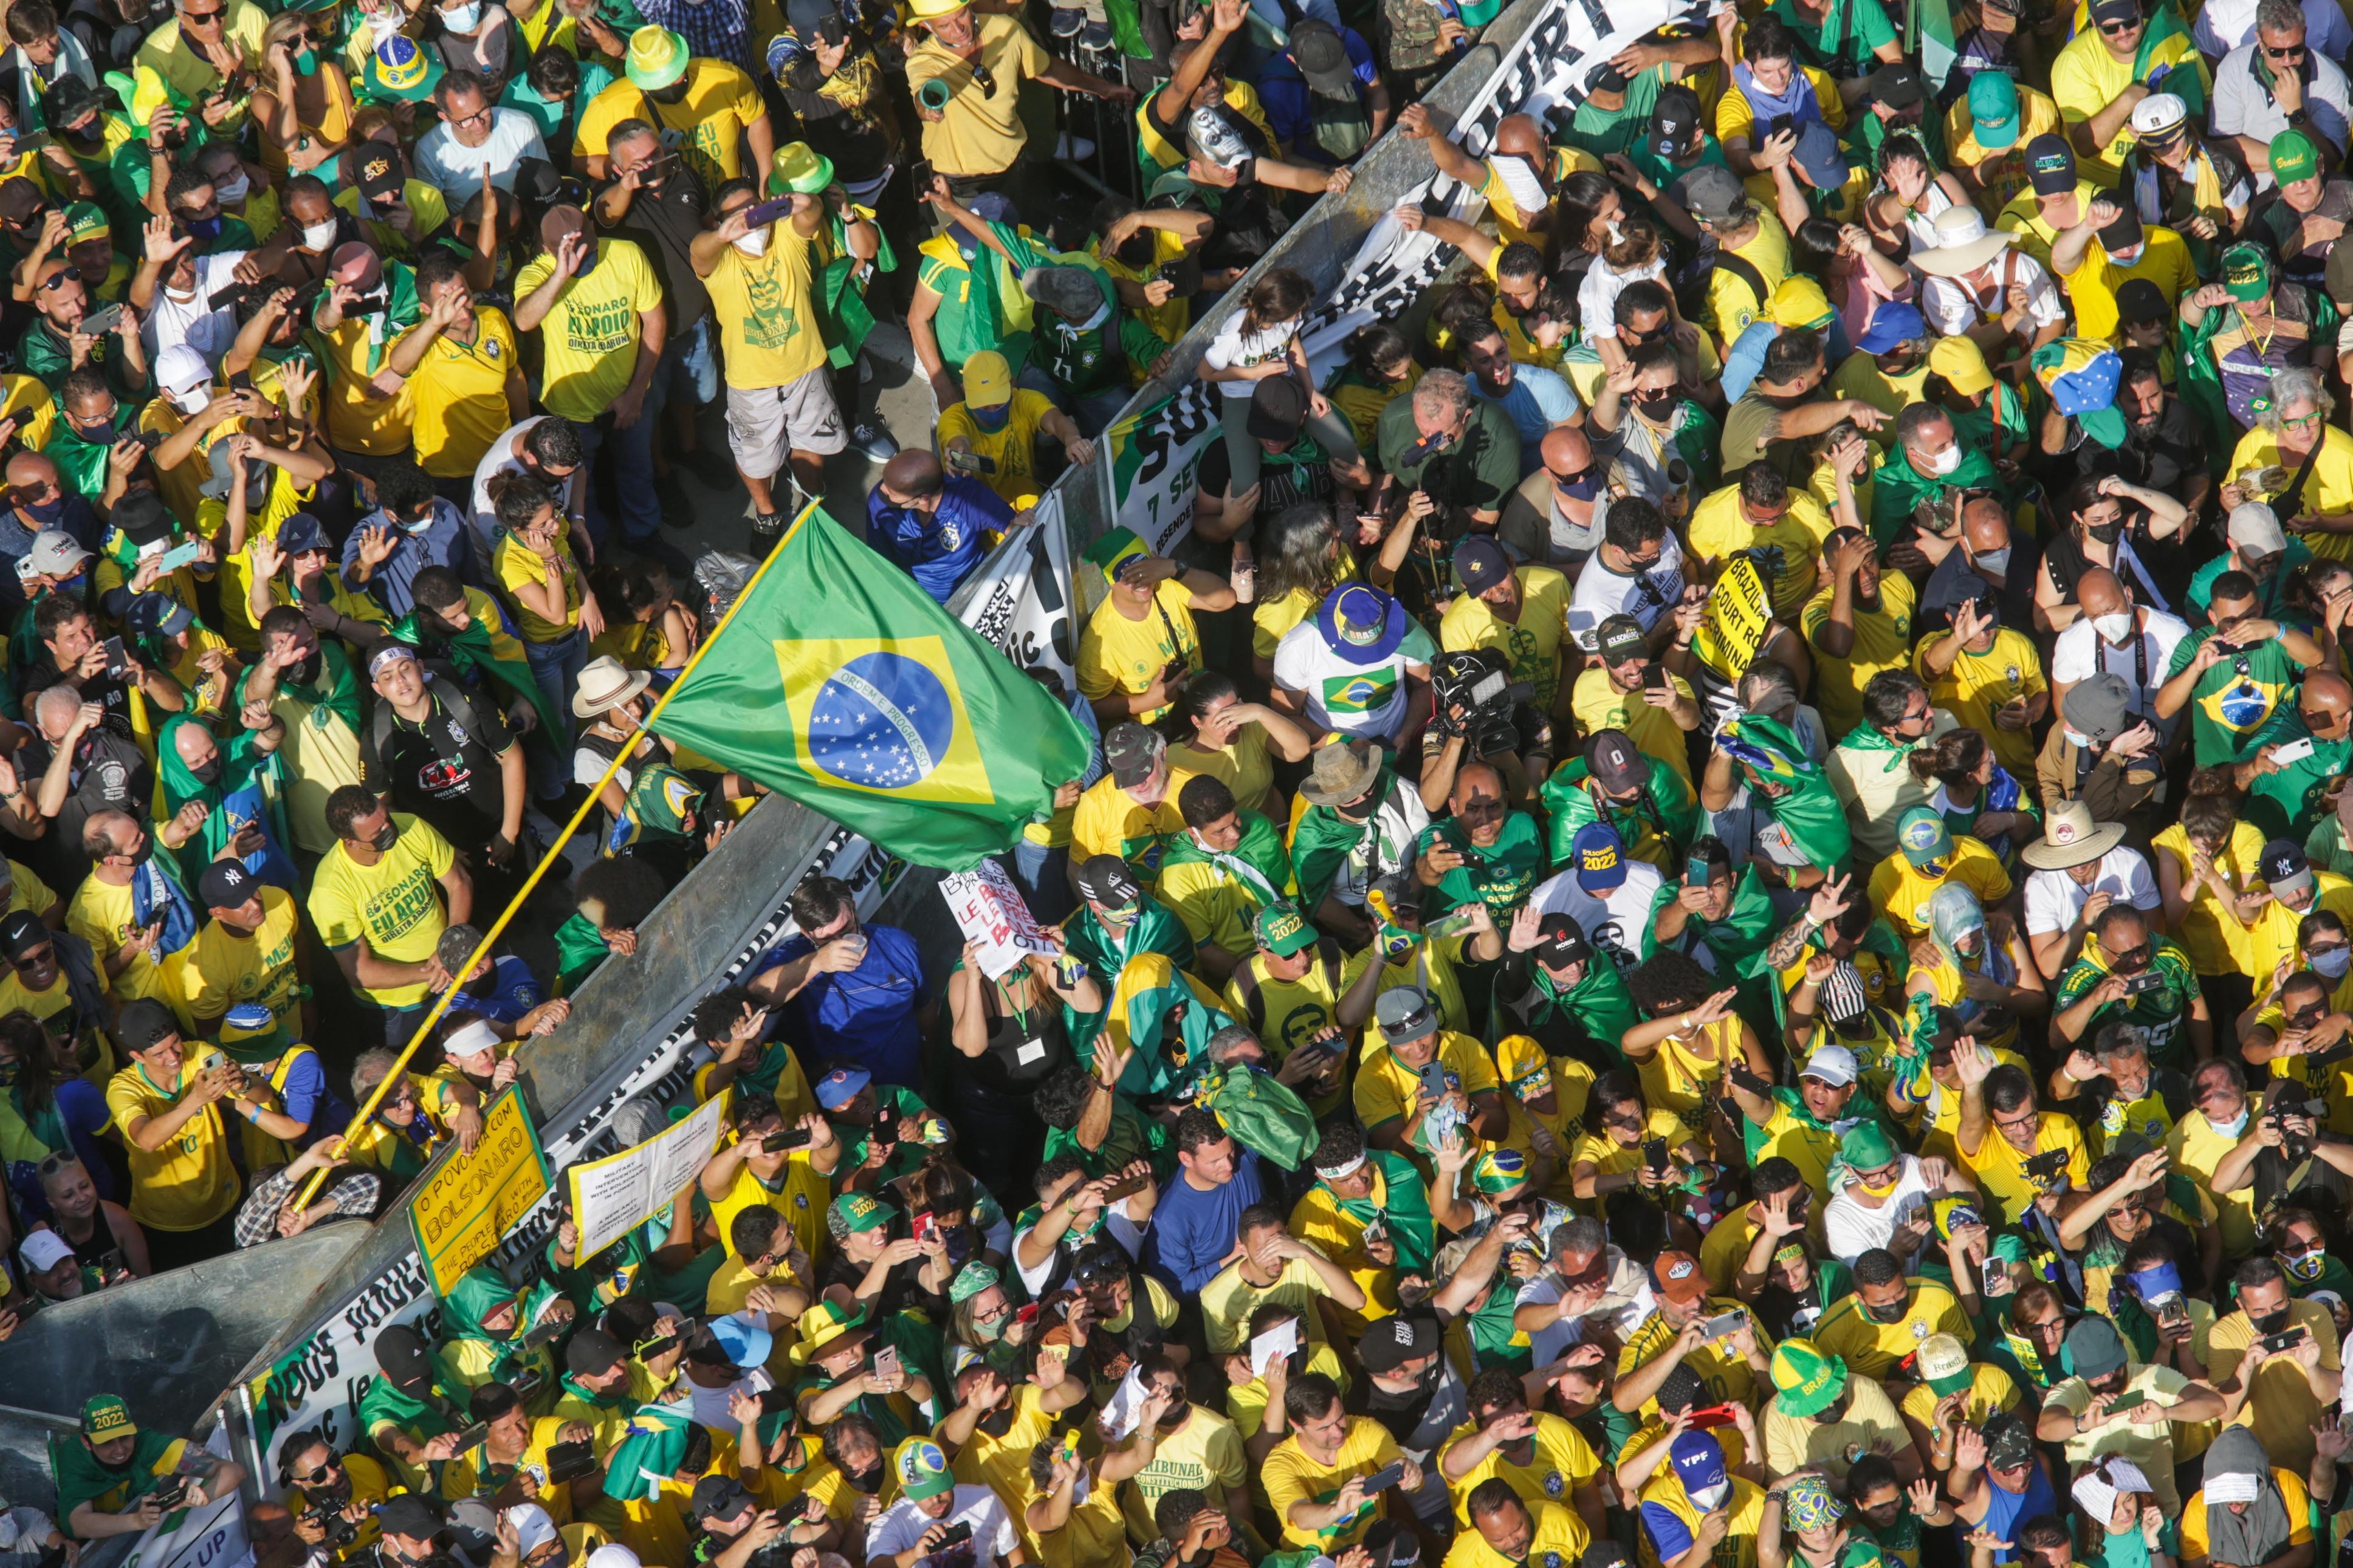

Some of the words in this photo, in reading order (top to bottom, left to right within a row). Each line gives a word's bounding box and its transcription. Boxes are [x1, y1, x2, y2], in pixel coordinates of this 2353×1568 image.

[2275, 152, 2304, 168] Brasil
[2228, 270, 2259, 284] 2022
[1147, 493, 1159, 525] 7
[1716, 583, 1744, 631] COURT
[1348, 625, 1382, 640] BRASIL
[1607, 631, 1639, 645] BOLSONARO
[841, 671, 877, 699] ORDEM
[878, 702, 885, 710] E
[888, 707, 928, 769] PROGRESSO
[1582, 845, 1613, 855] BOLSONARO
[1584, 852, 1617, 870] 2022
[371, 905, 394, 936] EU
[396, 872, 433, 919] APOIO
[958, 899, 980, 925] LE
[381, 921, 413, 943] DIREITA
[1272, 916, 1303, 941] 2022
[1555, 937, 1575, 950] MORIGI
[668, 1120, 709, 1152] CRIMINALIZE
[421, 1197, 430, 1211] O
[432, 1154, 469, 1199] POVO
[490, 1101, 512, 1131] COM
[595, 1163, 644, 1190] INTERVENTION
[604, 1161, 635, 1179] MILITARY
[425, 1126, 523, 1244] BOLSONARO
[590, 1188, 607, 1199] WITH
[609, 1166, 648, 1191] BOLSONARO
[614, 1180, 636, 1196] POWER
[439, 1254, 458, 1277] THE
[459, 1222, 492, 1257] PEOPLE
[510, 1175, 532, 1200] WITH
[592, 1208, 641, 1241] CONSTITUTION
[597, 1204, 638, 1231] COMMUNIST
[605, 1211, 620, 1222] NEW
[1671, 1261, 1691, 1276] MADE
[1933, 1356, 1960, 1372] Brasil
[267, 1333, 340, 1422] NOUS
[92, 1405, 122, 1417] BOLSONARO
[94, 1411, 126, 1429] 2022
[1680, 1450, 1708, 1467] YPF
[1135, 1474, 1204, 1488] CONSTITUCIONAL
